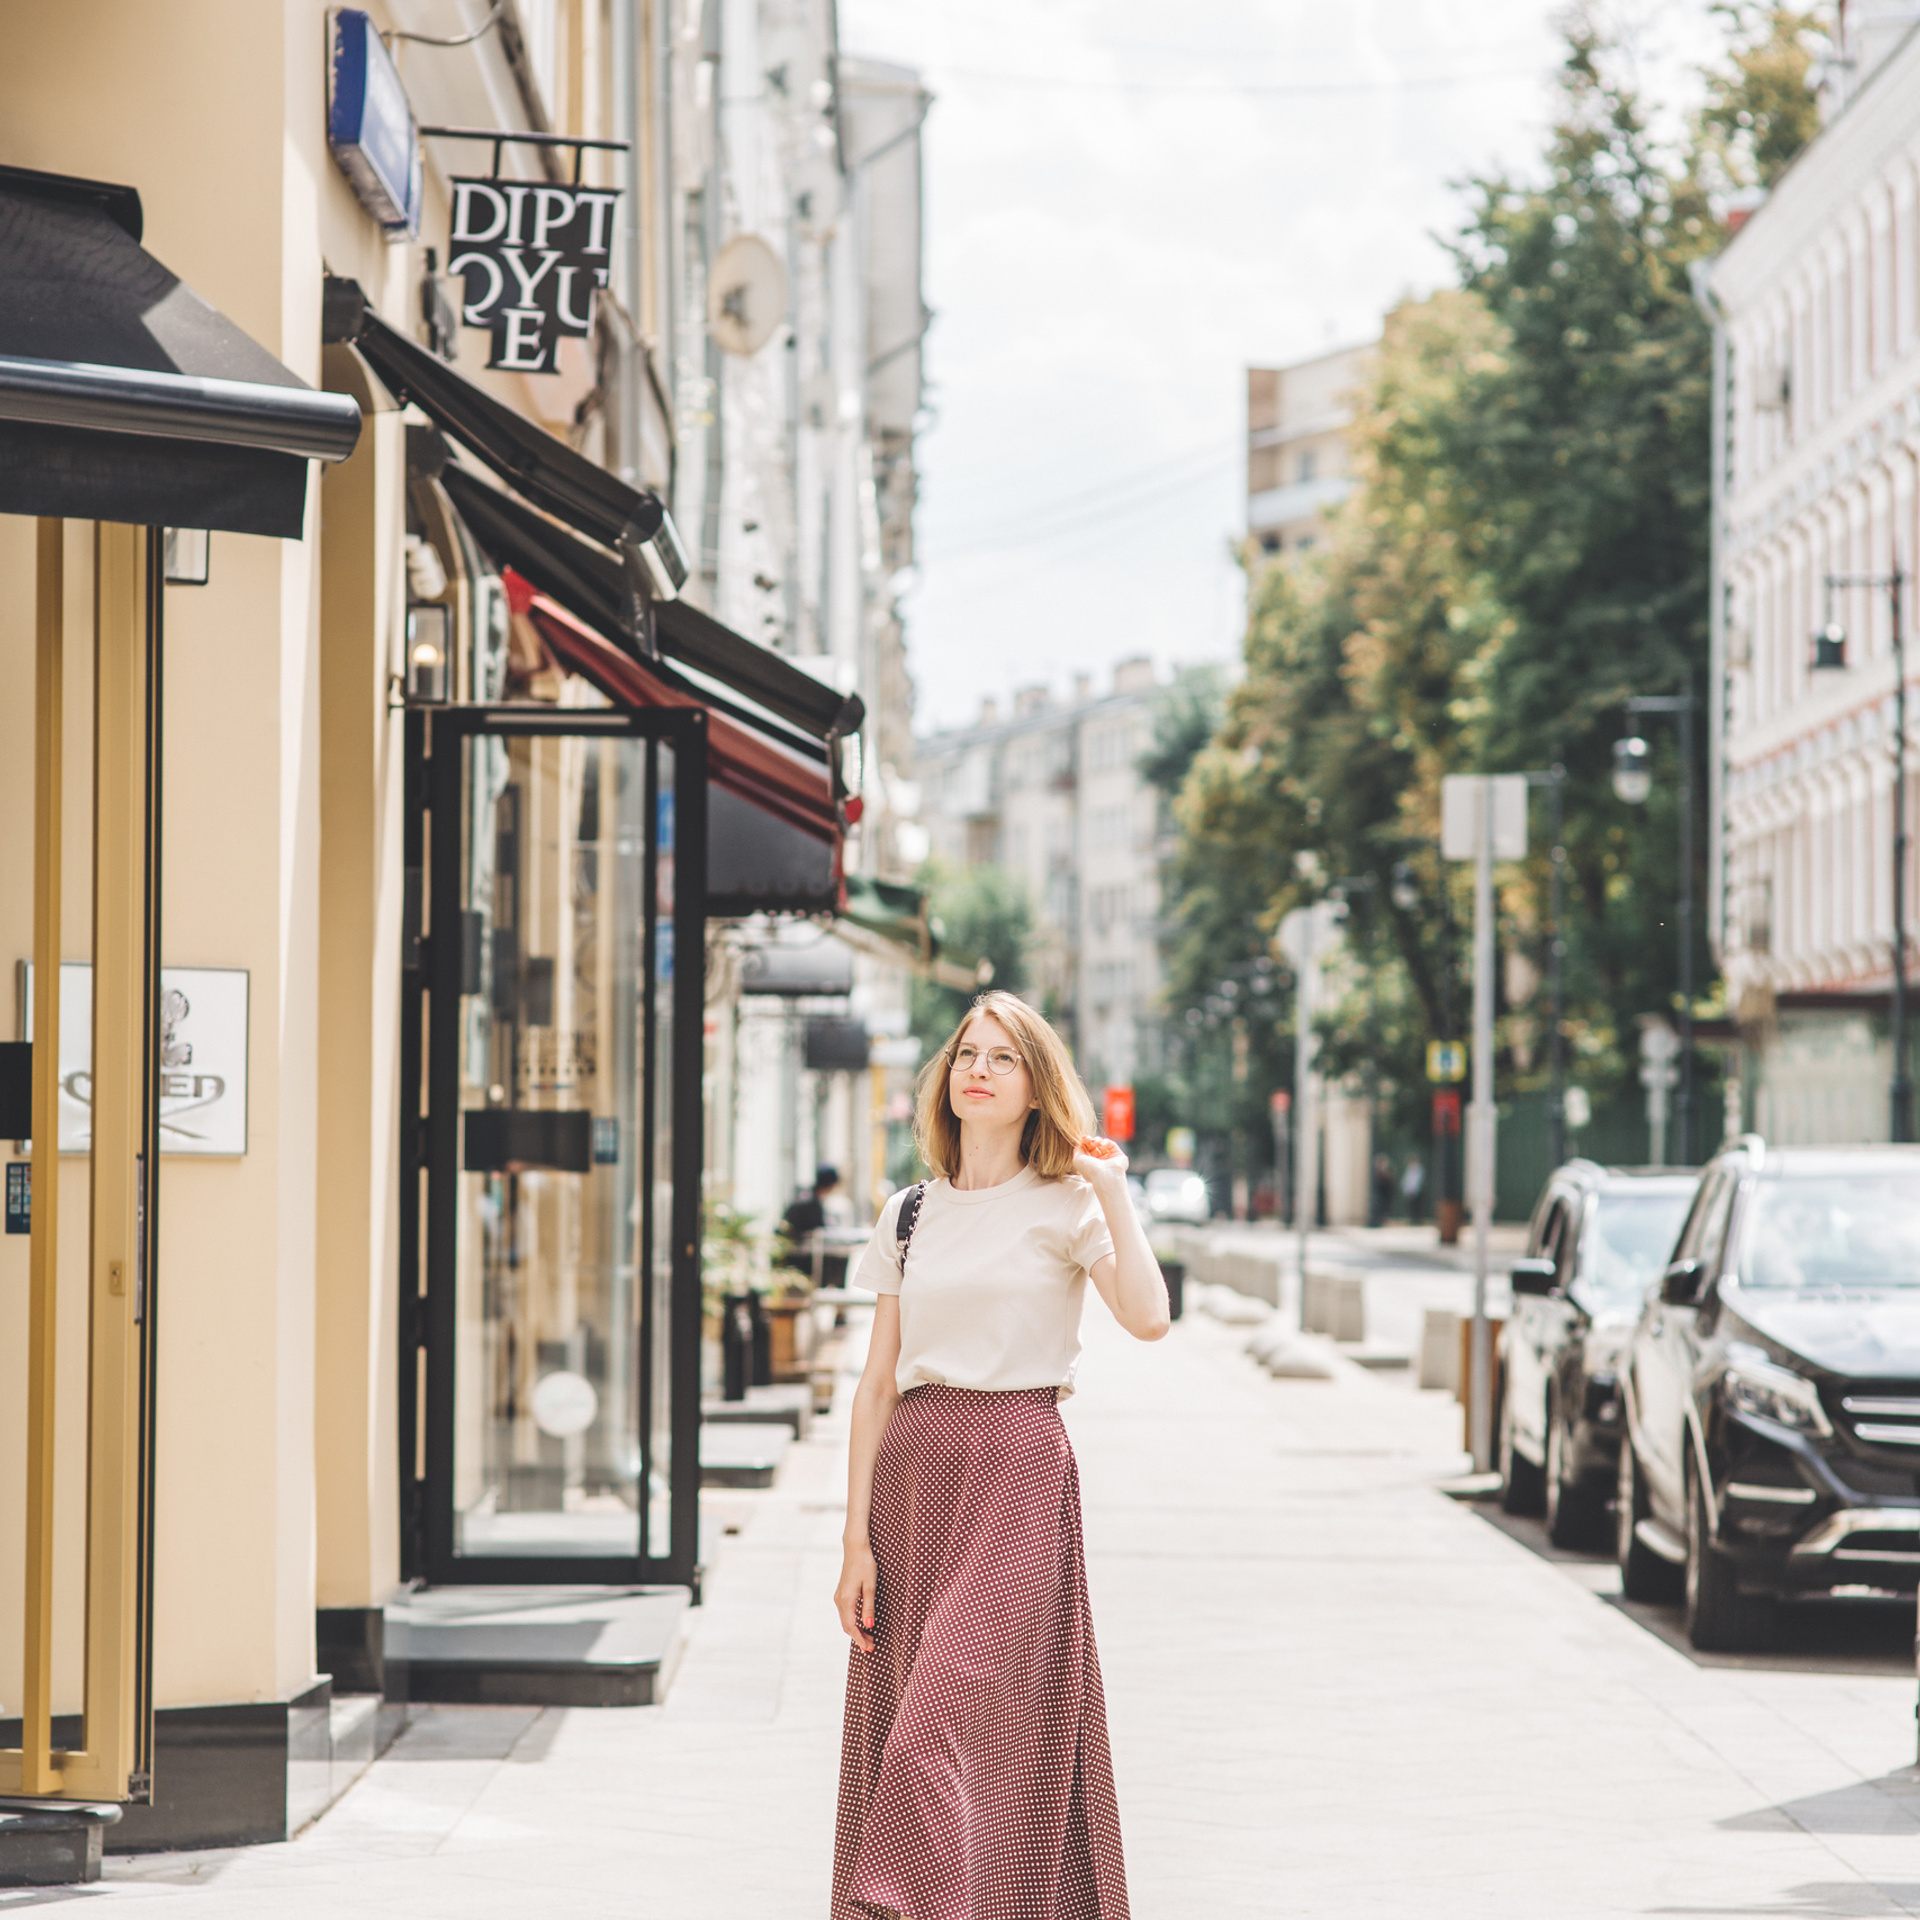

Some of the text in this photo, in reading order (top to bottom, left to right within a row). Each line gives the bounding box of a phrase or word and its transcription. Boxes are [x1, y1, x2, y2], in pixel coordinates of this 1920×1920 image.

[451, 182, 616, 255] DIPT
[448, 247, 609, 328] QYU
[497, 308, 547, 371] E
[64, 1071, 225, 1106] CED
